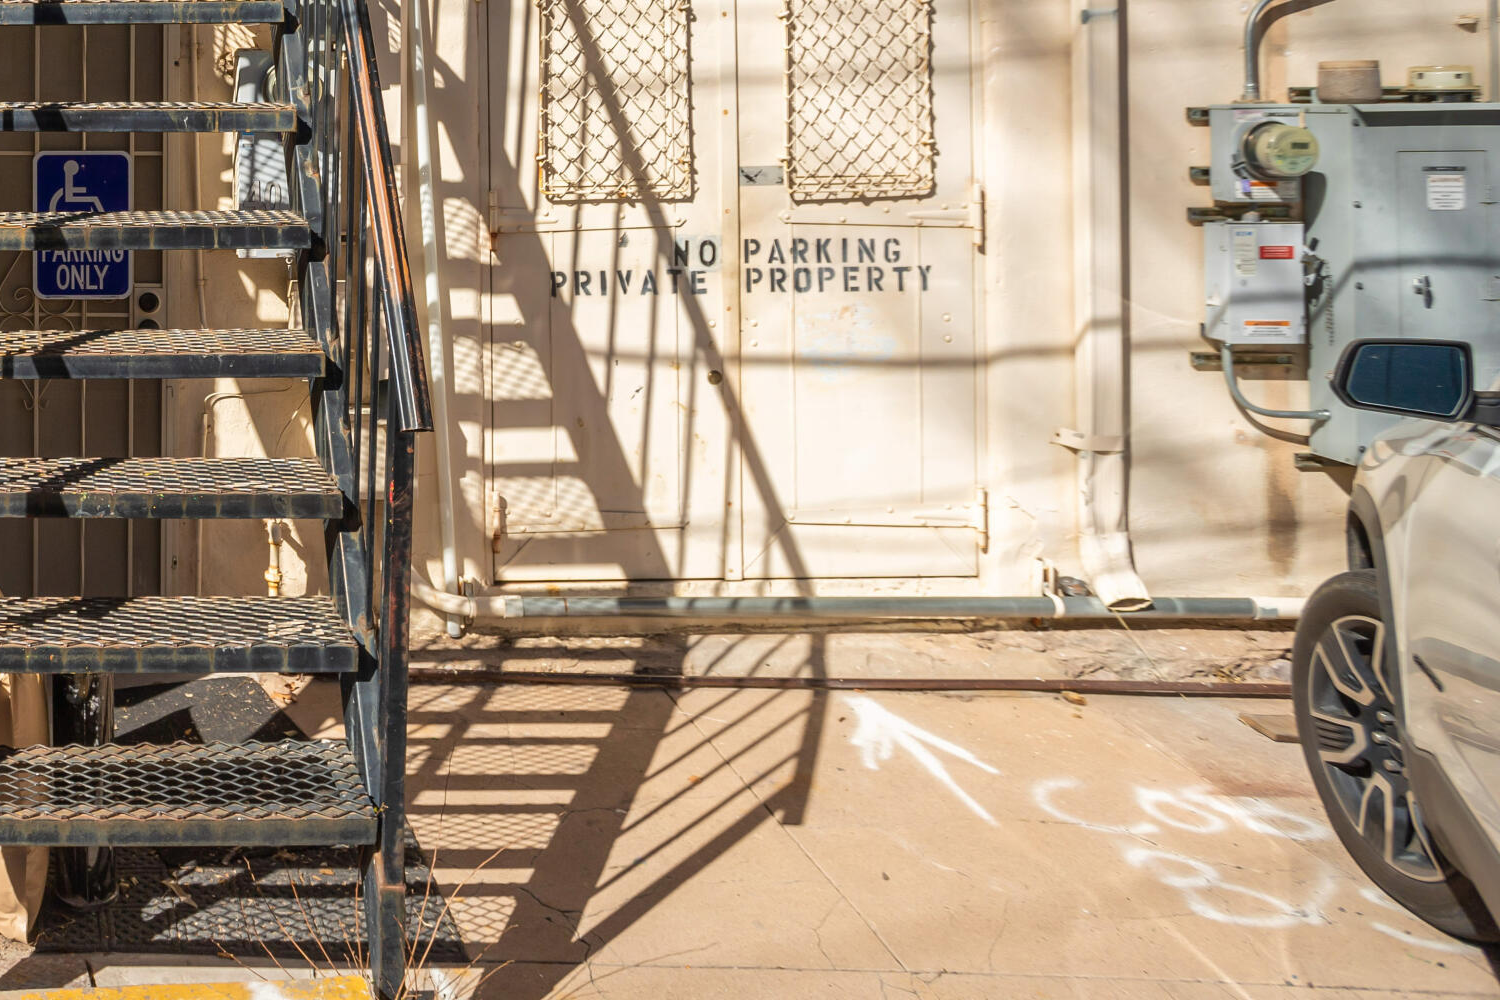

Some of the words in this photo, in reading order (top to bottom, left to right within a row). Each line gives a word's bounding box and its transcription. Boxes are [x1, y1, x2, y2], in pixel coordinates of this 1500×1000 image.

[673, 239, 717, 267] NO
[744, 237, 902, 264] PARKING
[56, 264, 109, 291] ONLY
[551, 269, 708, 297] PRIVATE
[746, 265, 932, 293] PROPERTY
